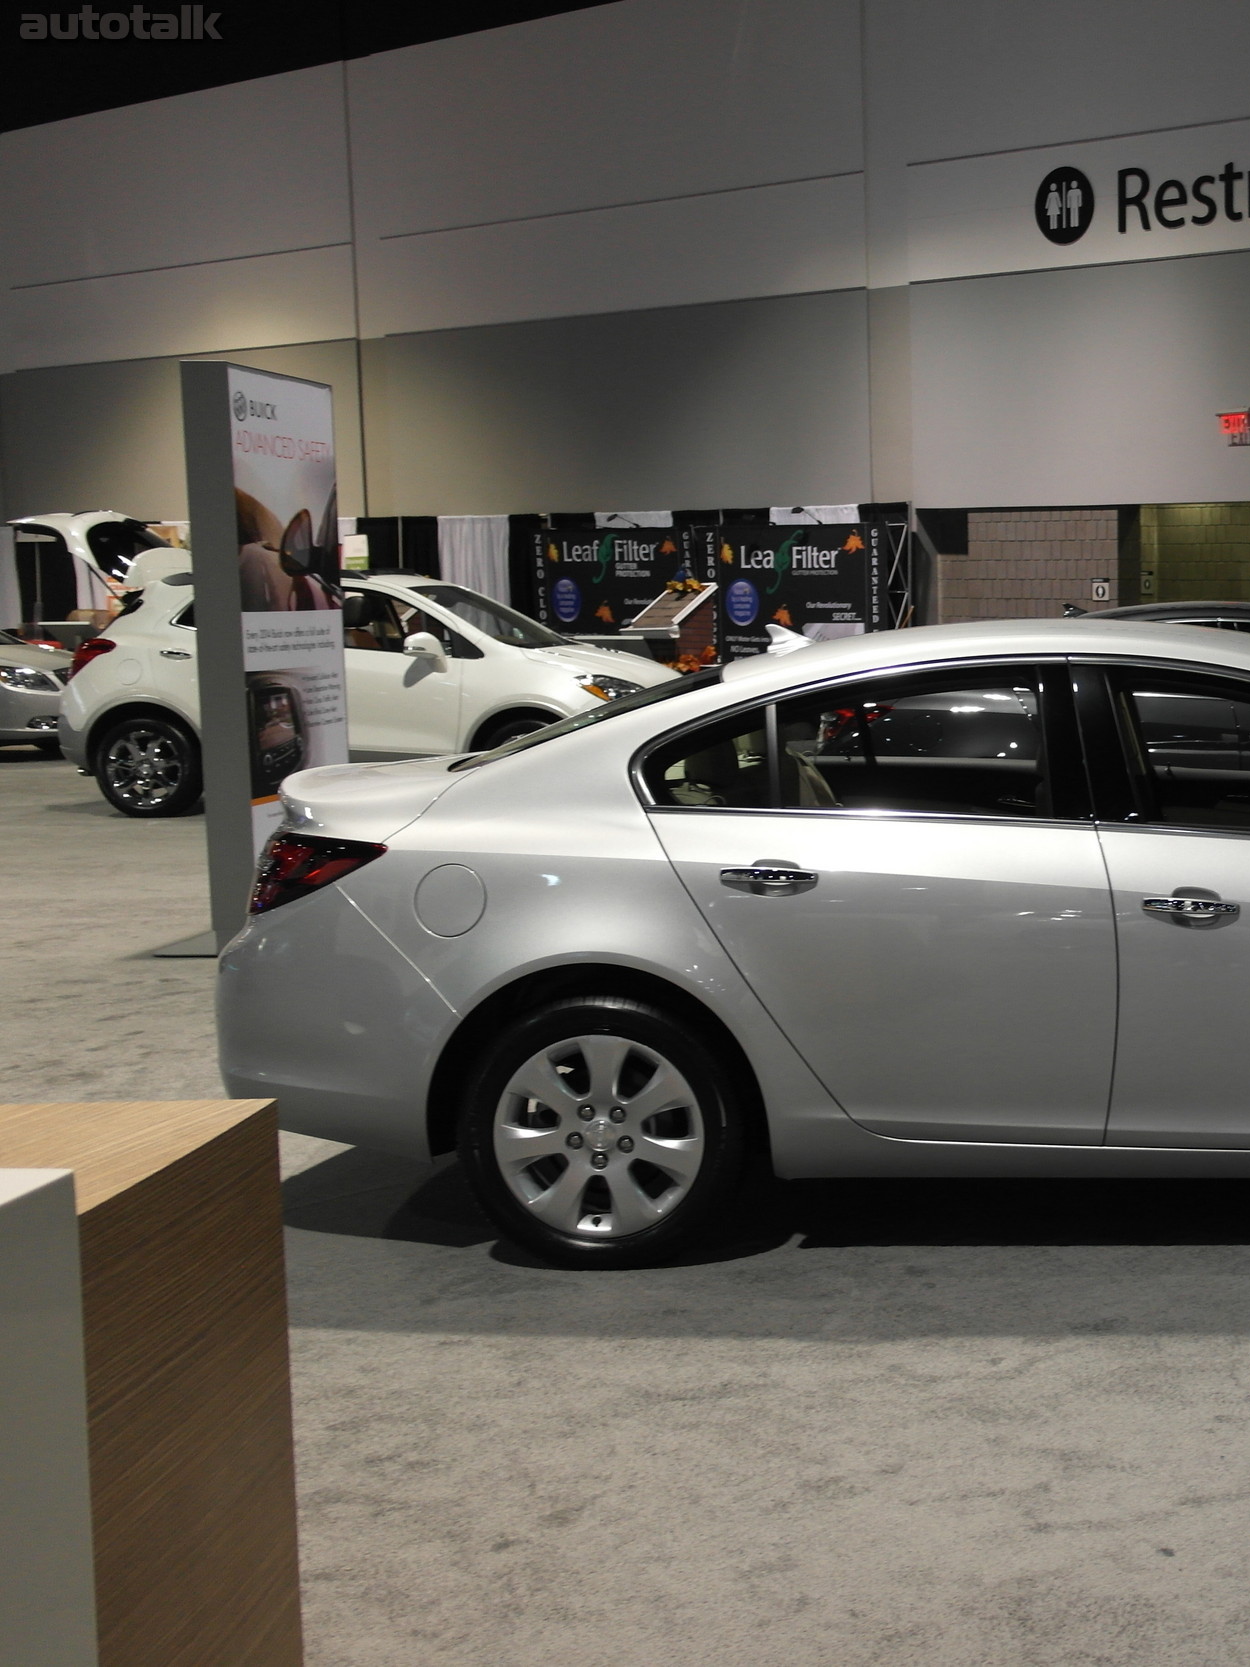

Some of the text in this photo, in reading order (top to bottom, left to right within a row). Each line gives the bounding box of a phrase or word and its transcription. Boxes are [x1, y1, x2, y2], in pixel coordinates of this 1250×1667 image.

[249, 400, 278, 420] BUICK
[236, 430, 295, 459] ADVANCED
[534, 534, 545, 579] ZERO
[562, 540, 656, 562] Leaf Filter
[706, 532, 716, 578] ZERO
[792, 545, 838, 569] Filter
[870, 528, 880, 623] GUARANTEED
